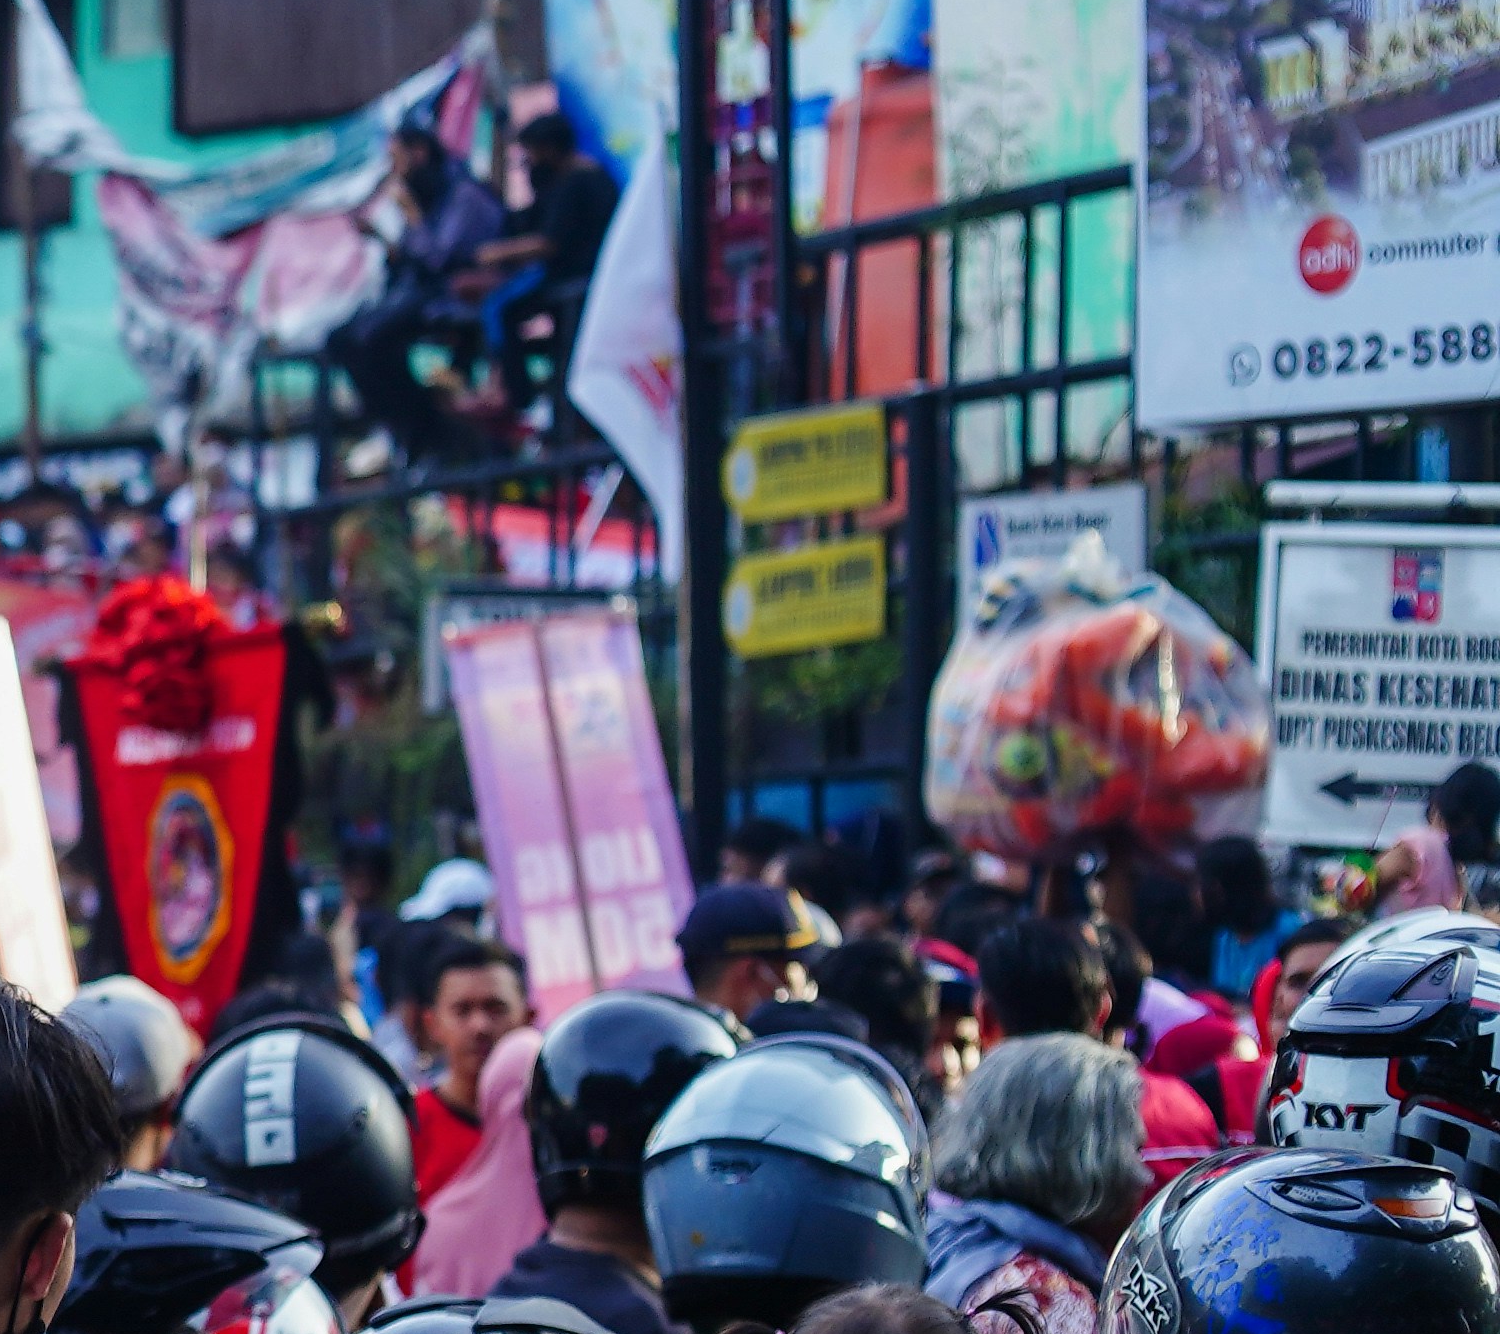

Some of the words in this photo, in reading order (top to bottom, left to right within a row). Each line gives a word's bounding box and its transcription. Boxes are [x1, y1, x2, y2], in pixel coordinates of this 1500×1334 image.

[1368, 231, 1489, 264] commuter
[1302, 629, 1416, 659] PEMERINTAH
[1417, 632, 1463, 661] KOTA
[1280, 668, 1370, 705] DINAS
[1278, 714, 1315, 748] UPT
[1323, 717, 1454, 755] PUSKESMAS
[1302, 1100, 1390, 1132] KYT
